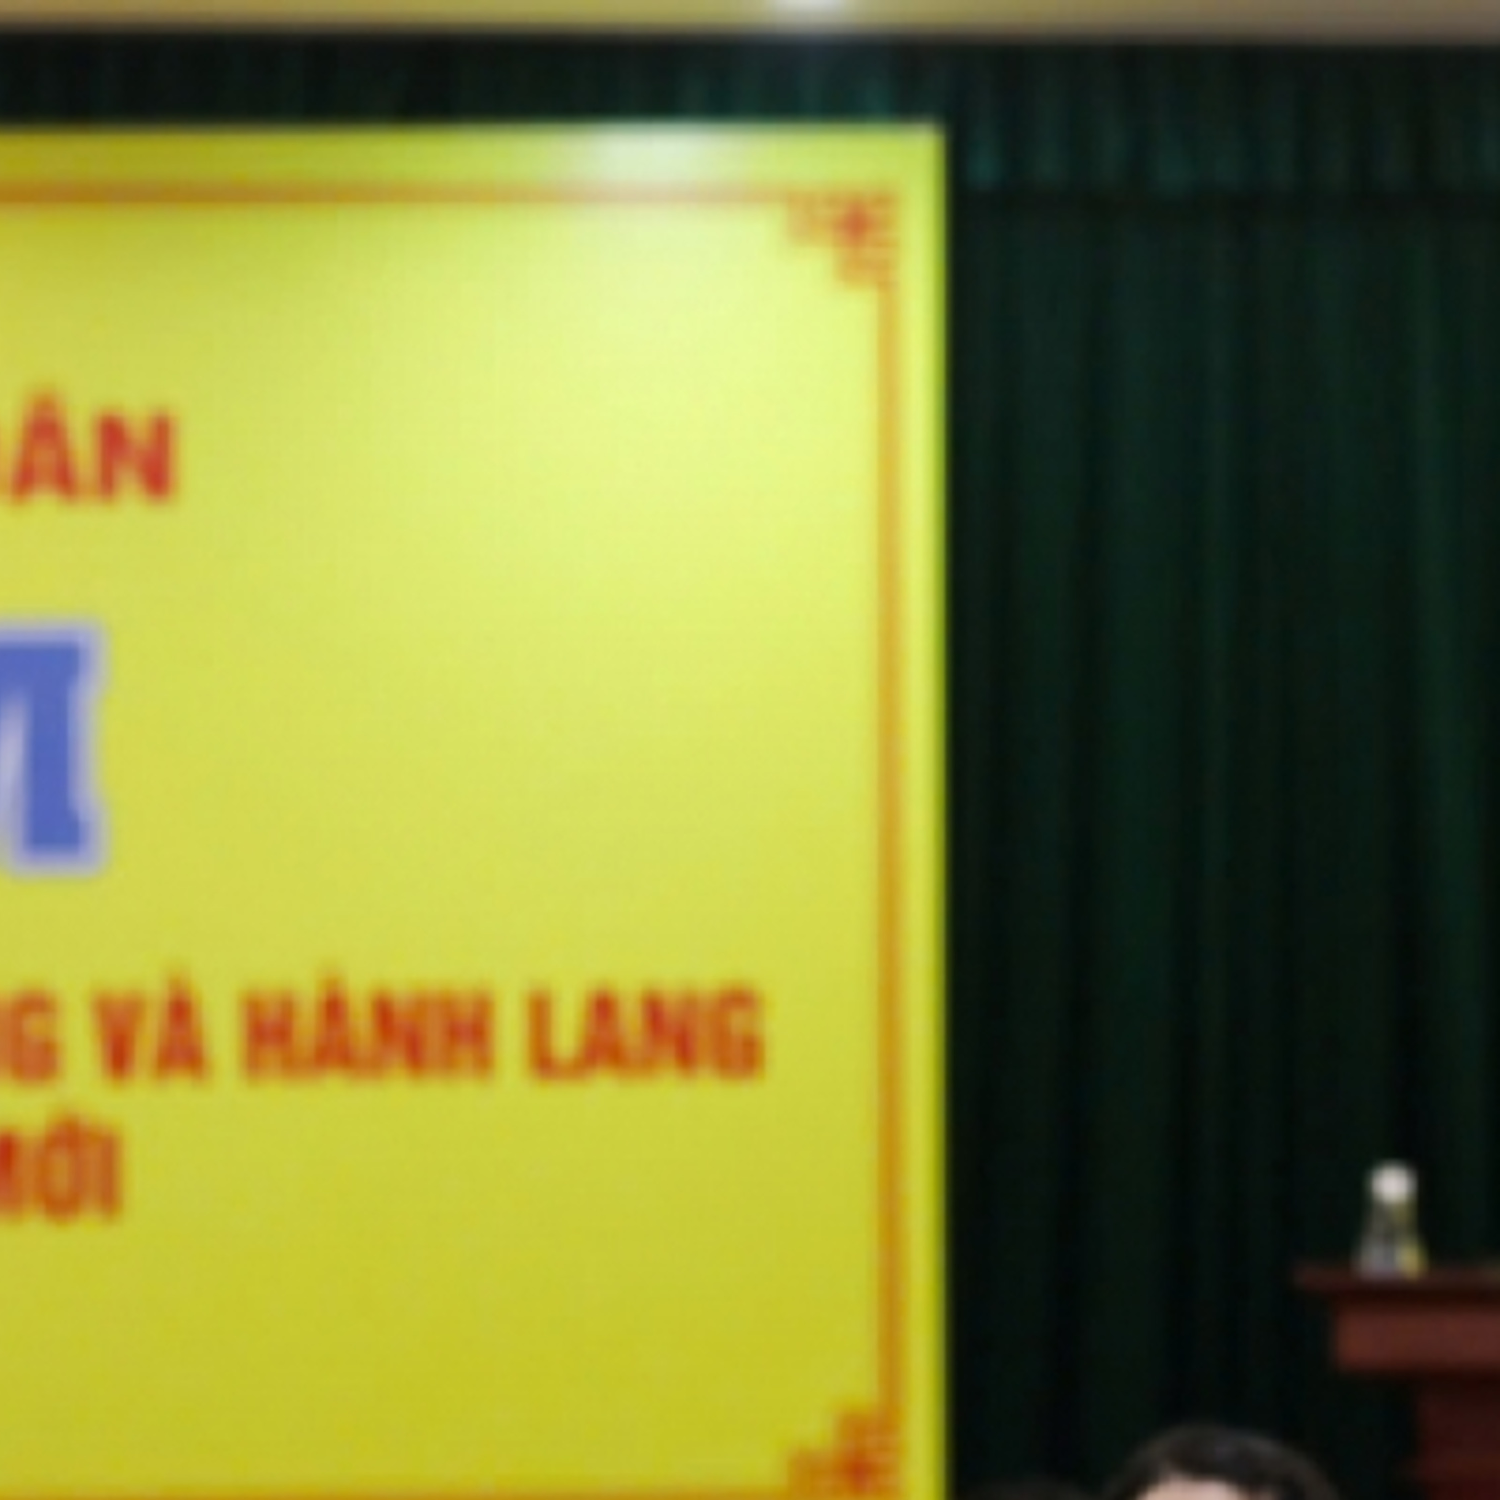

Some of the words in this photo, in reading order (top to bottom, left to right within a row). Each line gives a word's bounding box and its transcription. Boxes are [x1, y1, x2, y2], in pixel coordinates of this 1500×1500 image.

[92, 970, 208, 1084] VÀ
[240, 970, 494, 1084] HÀNH
[524, 984, 766, 1082] LANG
